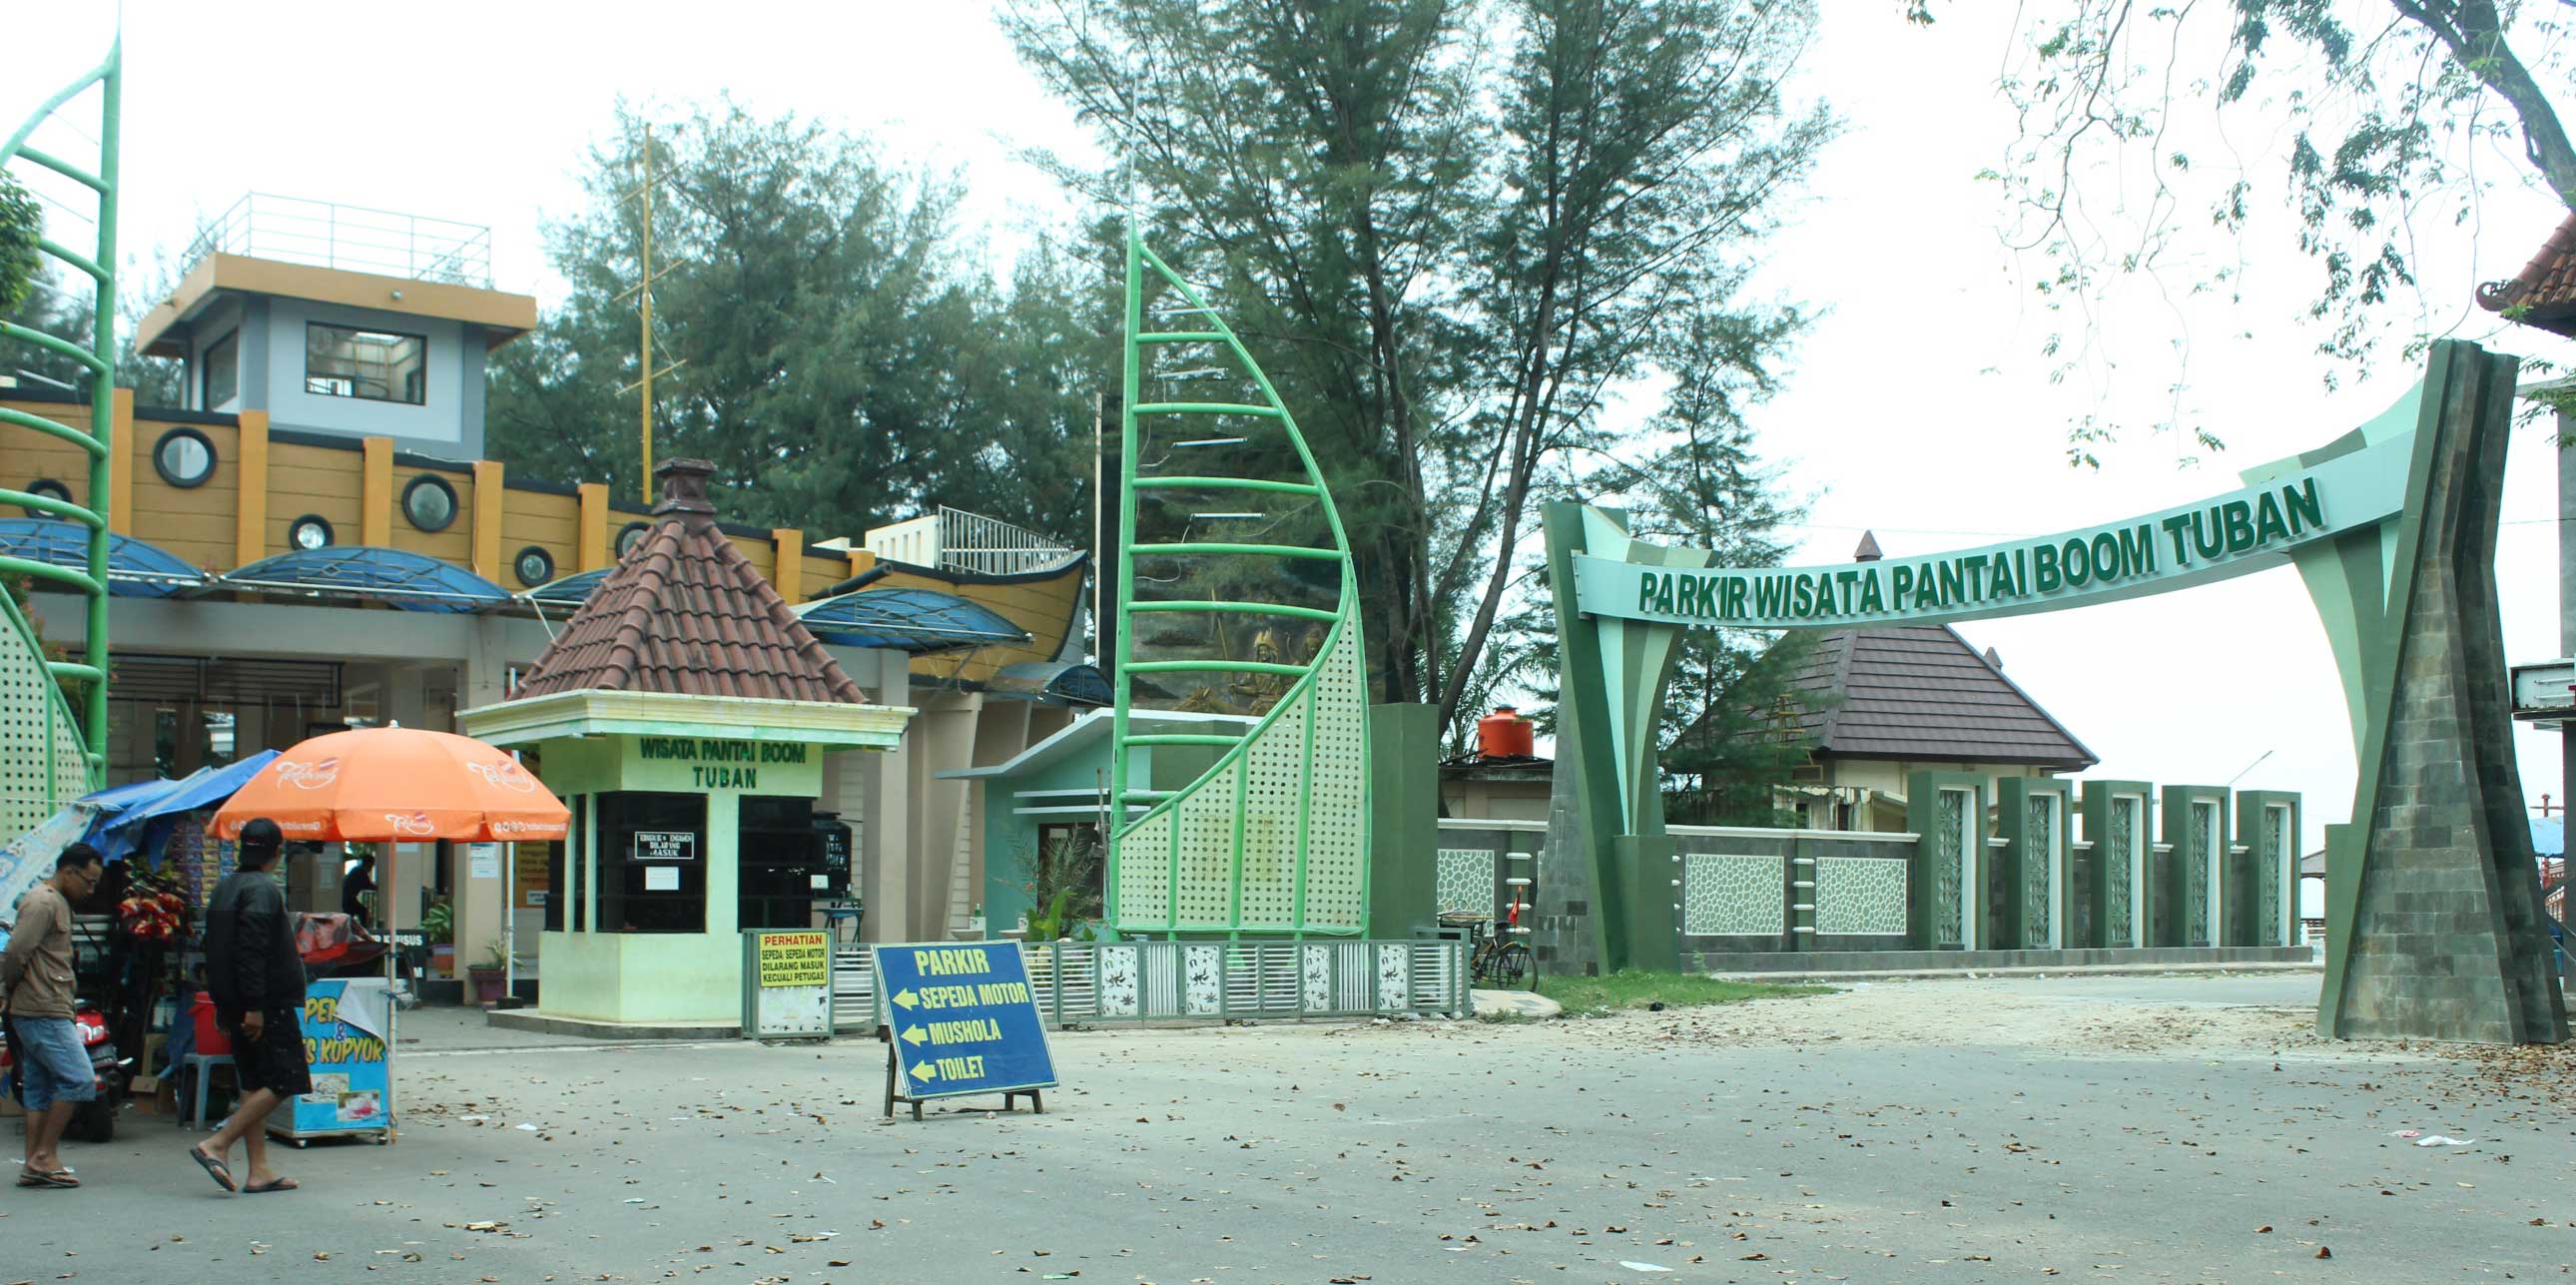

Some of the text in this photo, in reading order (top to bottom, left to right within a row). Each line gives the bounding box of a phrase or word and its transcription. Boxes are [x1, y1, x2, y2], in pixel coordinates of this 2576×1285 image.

[1638, 476, 2324, 619] PARKIR WISATA PANTAI BOOM TUBAN
[640, 738, 806, 764] WISATA PANTAI BOOM
[693, 766, 756, 789] TUBAN
[765, 935, 822, 946] PERHATIAN
[762, 961, 825, 971] DILARANG MASUK
[915, 949, 990, 975] PARKIR
[763, 971, 825, 982] KECUALI PETUGAS
[920, 982, 1029, 1009] SEPEDA MOTOR
[335, 1021, 345, 1042] &
[928, 1018, 1003, 1045] MUSHOLA
[321, 1036, 385, 1064] KOPYOR
[936, 1055, 985, 1081] TOILET
